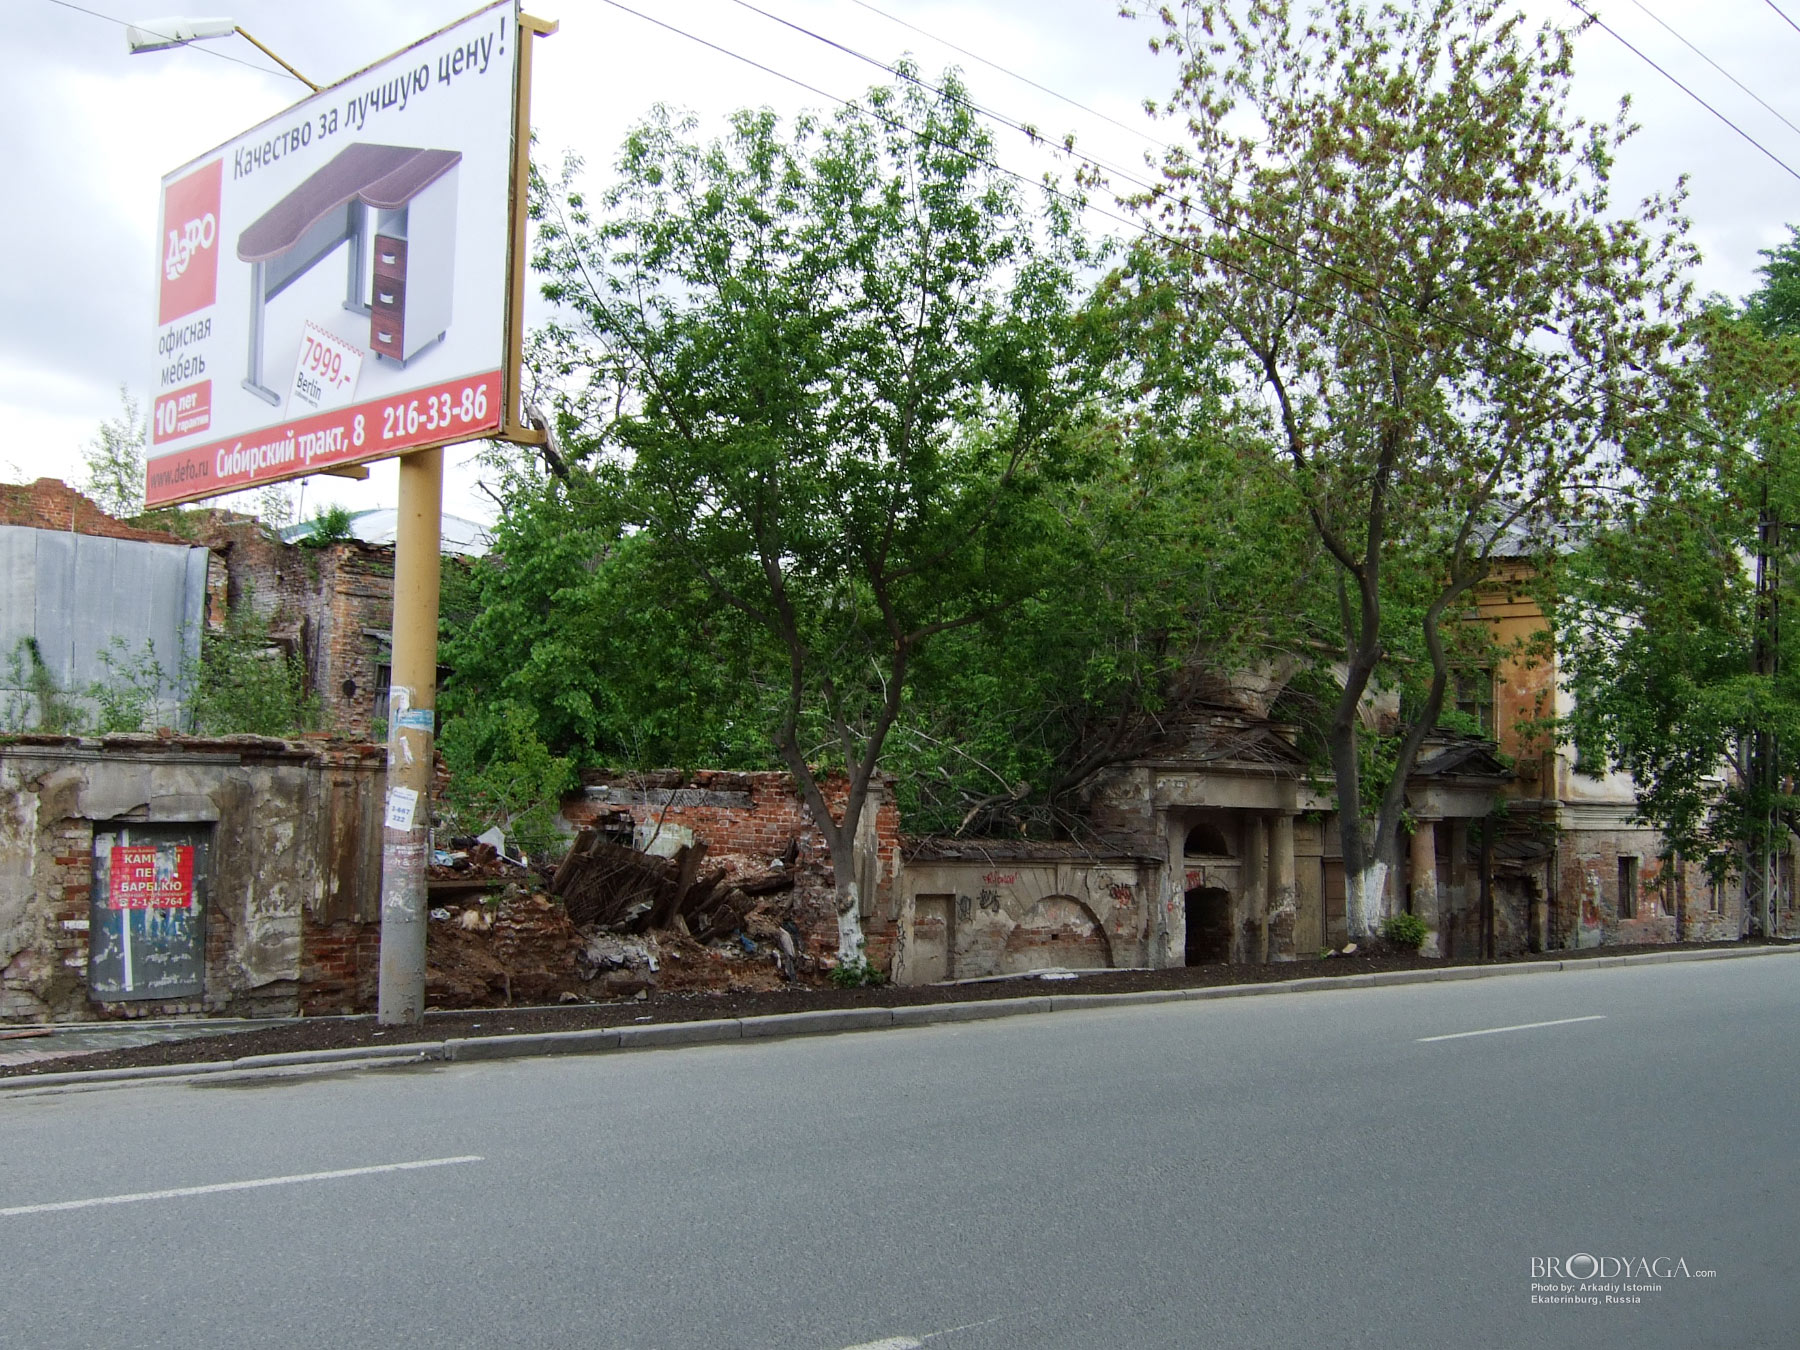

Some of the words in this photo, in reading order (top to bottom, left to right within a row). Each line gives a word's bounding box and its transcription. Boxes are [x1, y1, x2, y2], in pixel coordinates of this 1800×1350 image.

[234, 121, 311, 180] Качество
[318, 108, 338, 139] за
[344, 64, 430, 131] лучшую
[159, 318, 212, 358] офисная
[161, 353, 206, 387] мебель
[297, 371, 322, 400] Berlin
[178, 392, 198, 411] лет
[156, 399, 178, 436] 10
[177, 414, 210, 432] гарантии
[216, 430, 295, 479] Сибирский
[299, 426, 349, 465] тракт,
[353, 414, 366, 447] 8
[383, 384, 488, 440] 216-33-86
[151, 459, 210, 488] www.defo.ru
[124, 853, 181, 864] КАМ
